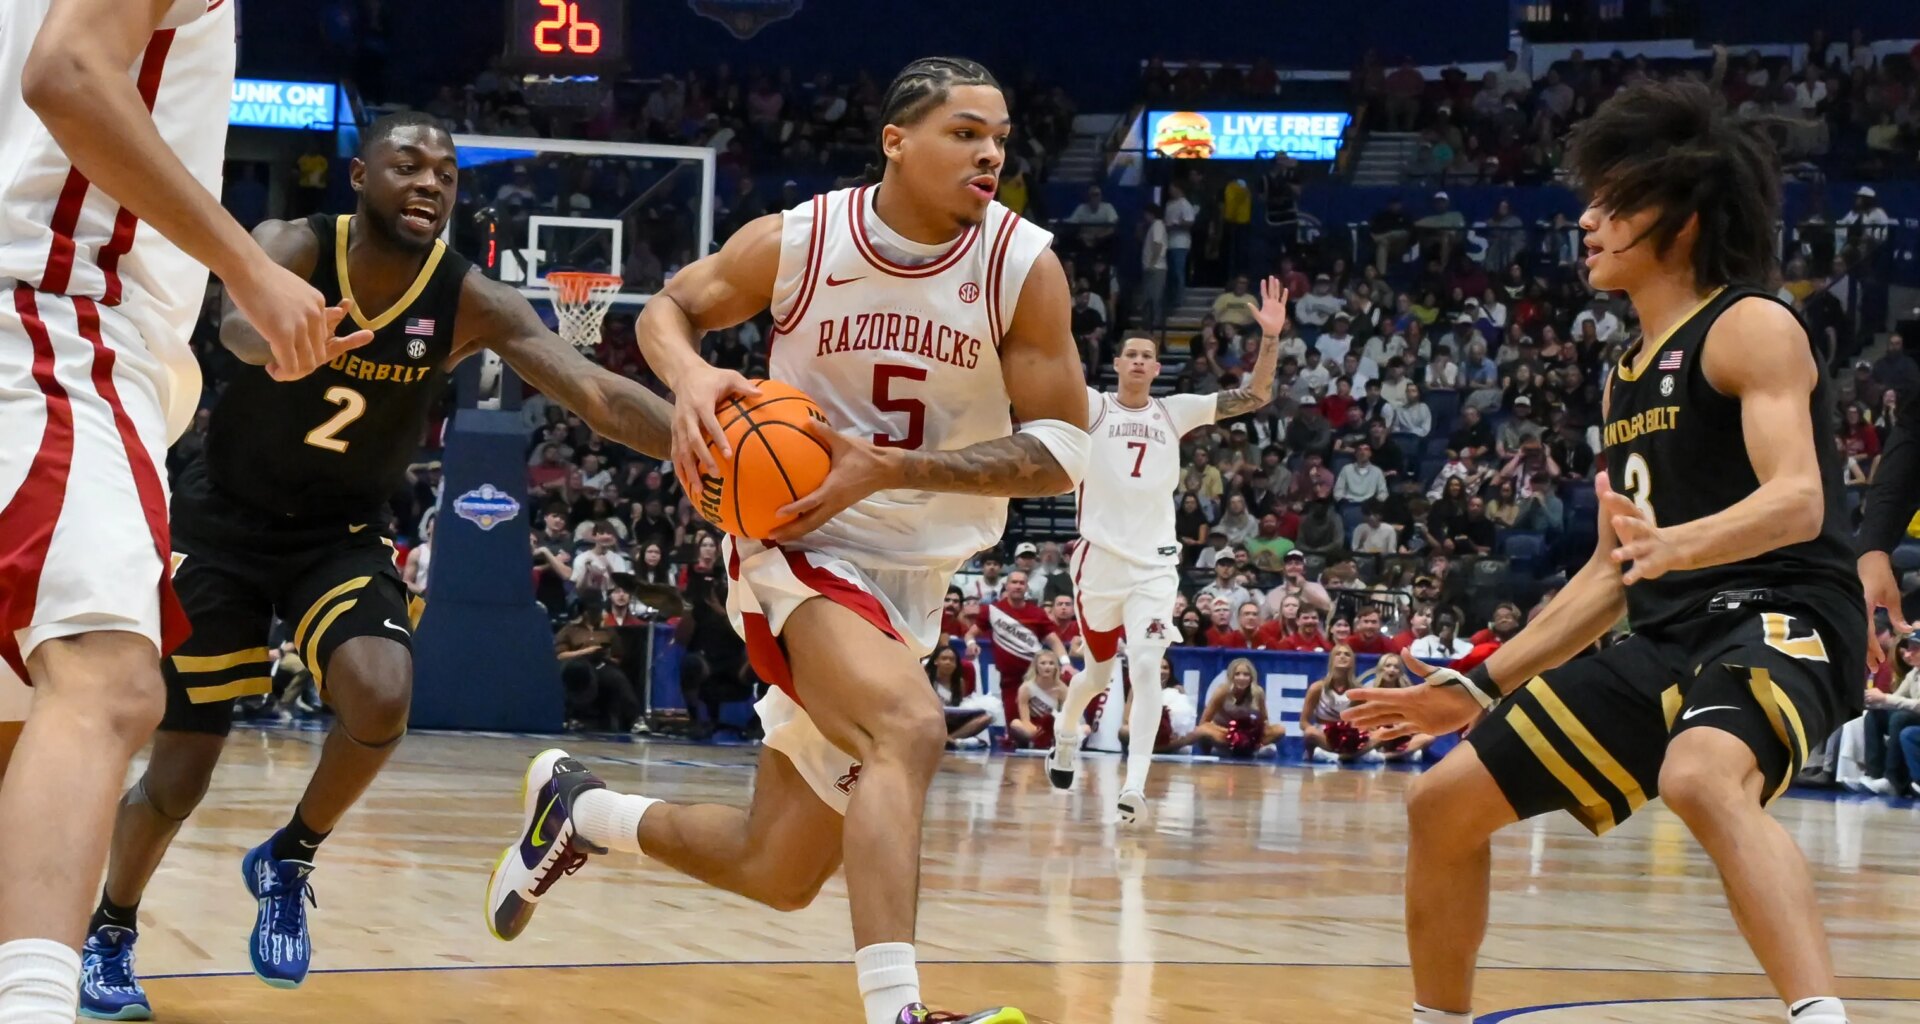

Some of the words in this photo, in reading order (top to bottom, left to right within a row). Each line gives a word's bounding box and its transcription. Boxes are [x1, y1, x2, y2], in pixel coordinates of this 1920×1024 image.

[534, 0, 600, 53] 26
[287, 85, 325, 106] ON
[1223, 115, 1277, 136] LIVE
[1281, 116, 1339, 136] FREE
[1218, 136, 1262, 155] EAT
[959, 283, 979, 303] SEC
[408, 340, 426, 358] SEC
[817, 313, 981, 369] RAZORBACKS
[304, 386, 366, 453] 2
[872, 364, 927, 450] 5
[1127, 441, 1147, 478] 7
[1624, 453, 1657, 528] 3
